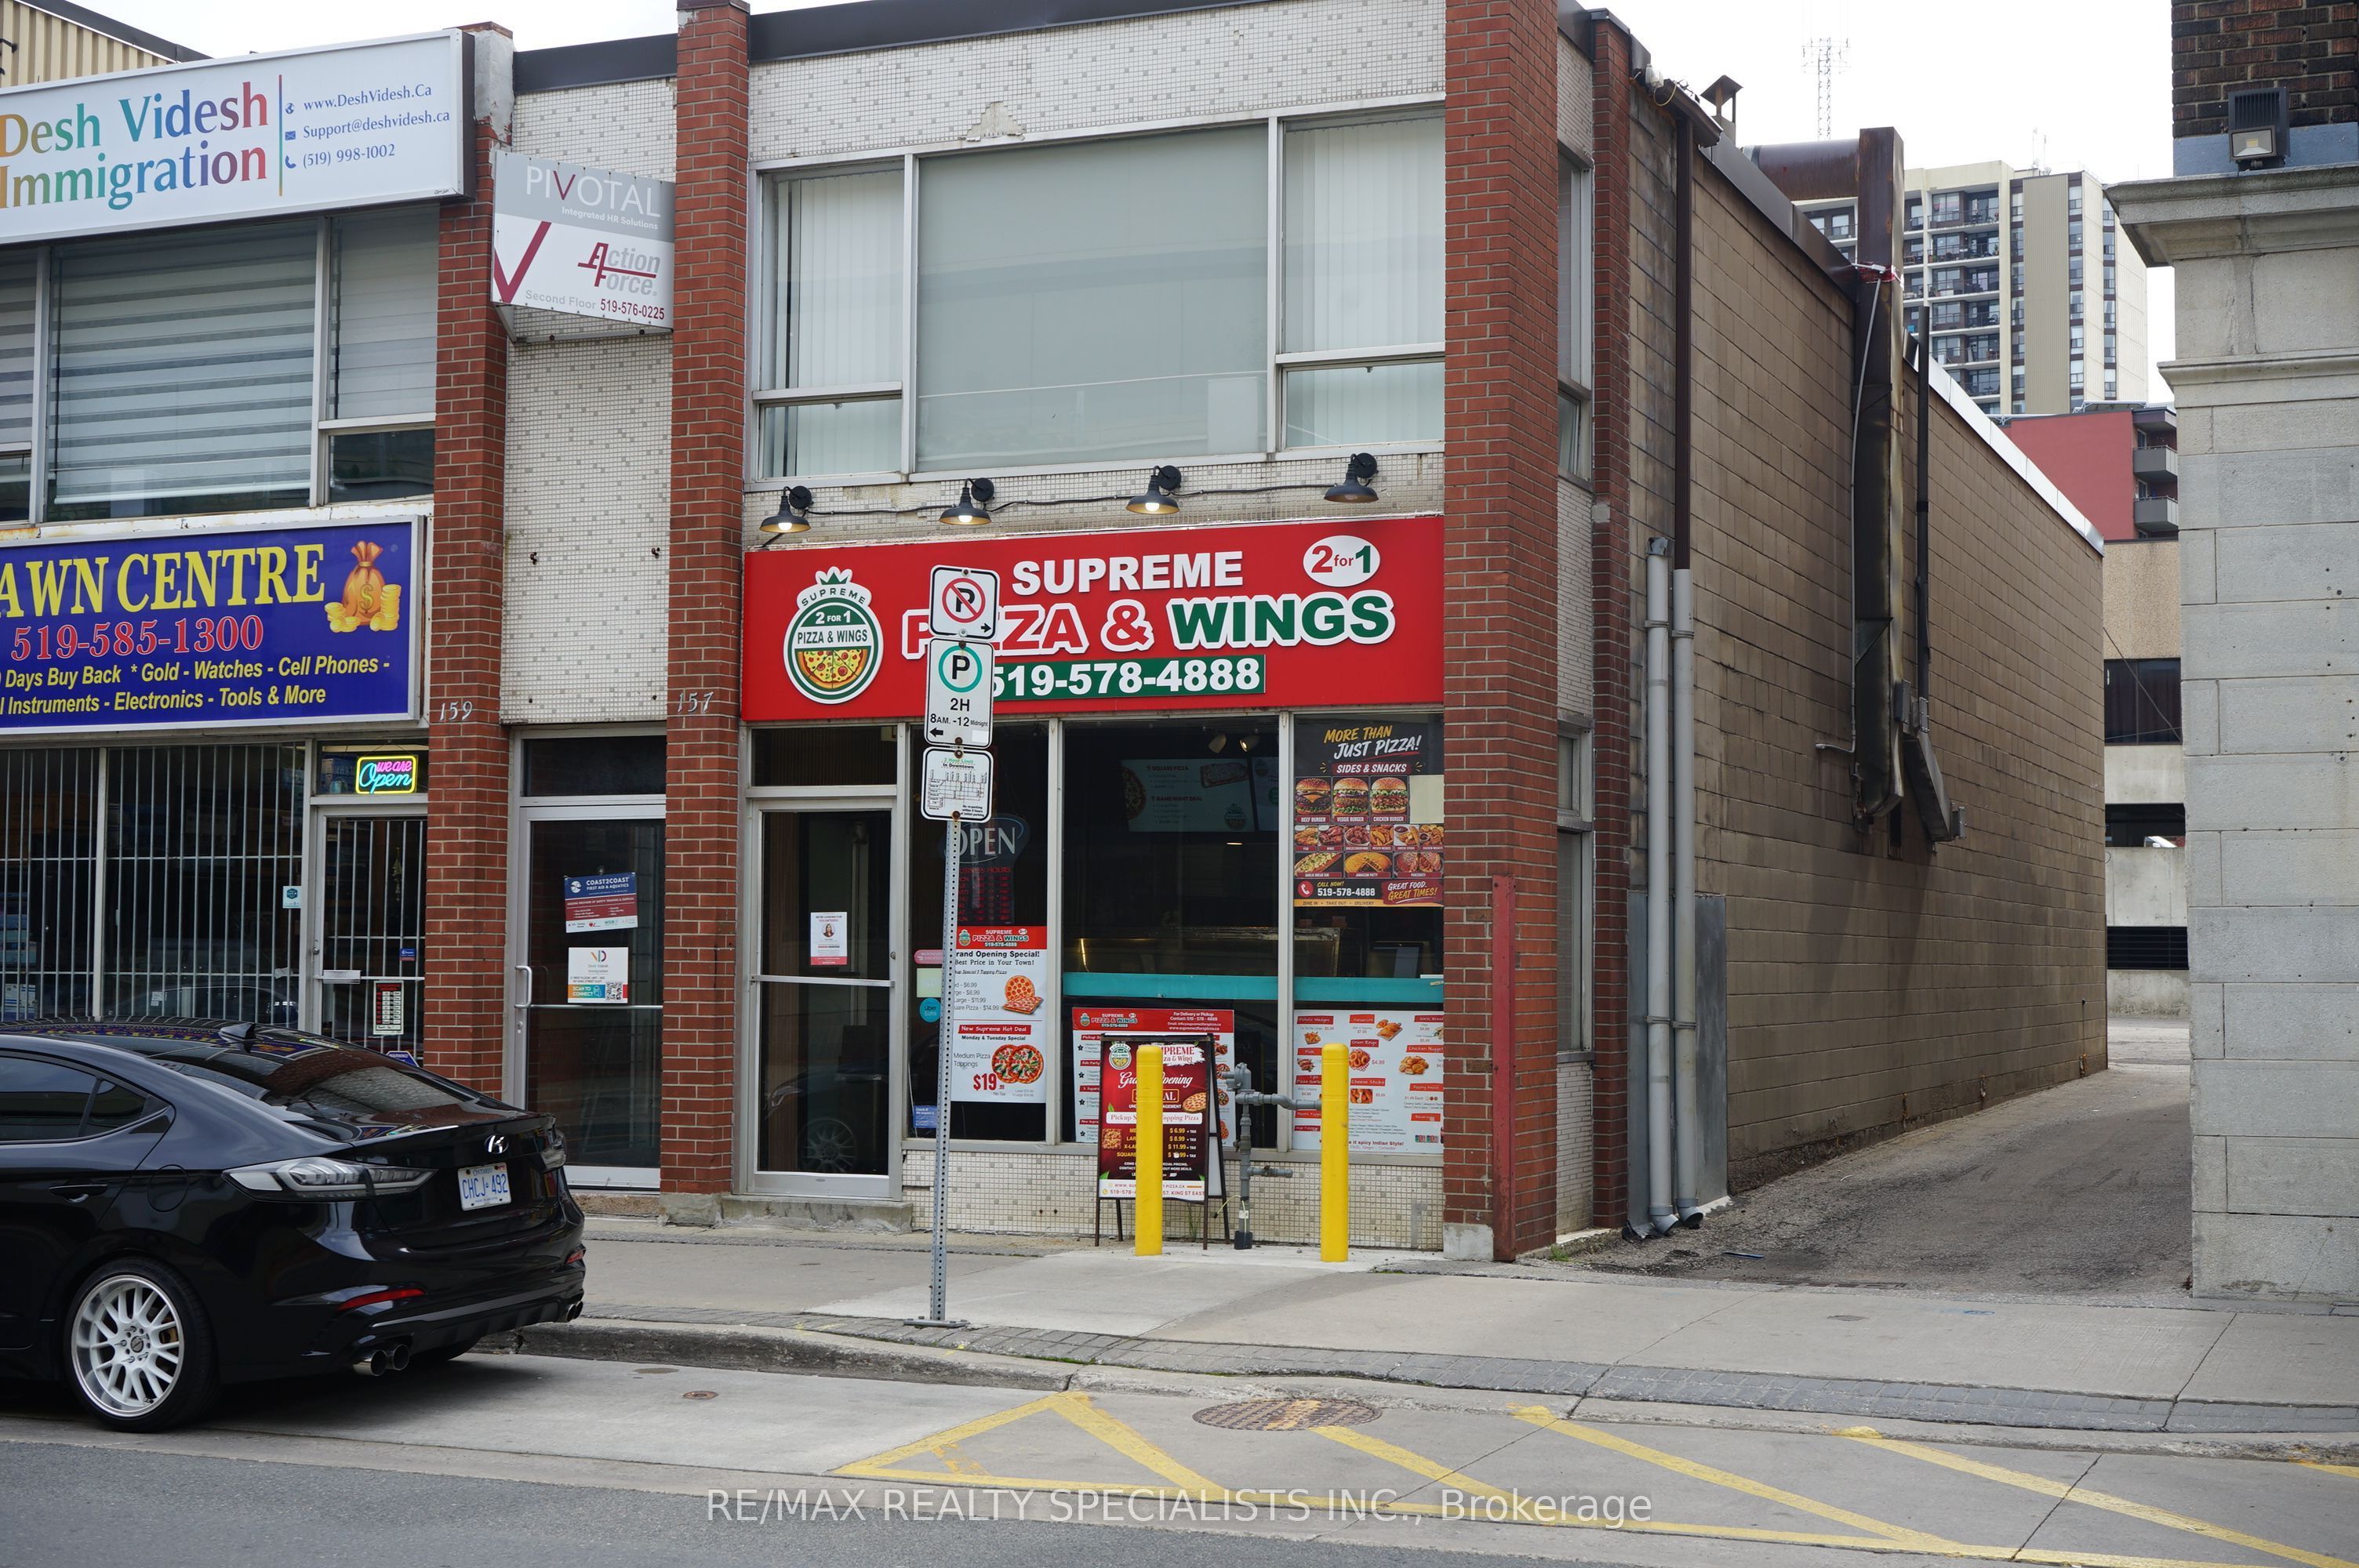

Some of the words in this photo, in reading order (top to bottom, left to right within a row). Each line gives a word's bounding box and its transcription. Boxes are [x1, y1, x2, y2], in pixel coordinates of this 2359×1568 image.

[304, 84, 431, 111] www.DeshVidesh.Ca
[0, 103, 100, 157] Desh
[118, 82, 267, 141] Videsh
[304, 110, 449, 139] Support@deshvidesh.ca
[303, 151, 331, 169] (519)
[337, 143, 394, 163] 998-1002
[0, 140, 267, 210] Immigration
[526, 165, 660, 217] PIVOTAL
[562, 207, 605, 222] Integrated
[607, 214, 619, 223] HR
[621, 216, 658, 230] Solutions
[525, 290, 565, 306] Second
[569, 297, 596, 310] Floor
[601, 299, 665, 320] 519-576-0225
[117, 544, 325, 612] CENTRE
[1012, 550, 1244, 596] SUPREME
[801, 588, 865, 606] SUPREME
[816, 612, 825, 624] 2
[844, 611, 850, 622] 1
[903, 603, 1089, 659] PZA
[1100, 599, 1154, 652] &
[1167, 590, 1394, 650] WINGS
[11, 614, 264, 661] 519-585-1300
[798, 631, 823, 644] PIZZA
[827, 631, 833, 642] &
[837, 630, 867, 642] WINGS
[5, 670, 43, 691] Days
[47, 668, 77, 690] Buy
[82, 666, 121, 684] Back
[142, 662, 179, 682] Gold
[194, 660, 263, 680] Watches
[278, 657, 310, 676] Cell
[315, 655, 379, 674] Phones
[952, 655, 970, 679] P
[994, 658, 1259, 697] 519-578-4888
[9, 695, 100, 714] Instruments
[114, 690, 203, 711] Electronics
[220, 688, 261, 706] Tools
[267, 686, 278, 704] &
[285, 685, 325, 704] More
[440, 701, 473, 722] 159
[678, 692, 714, 713] 157
[951, 698, 969, 711] 2H
[1325, 728, 1359, 743] MORE
[1363, 725, 1392, 739] THAN
[1334, 741, 1372, 759] JUST
[1375, 735, 1422, 757] PIZZA!
[360, 763, 412, 793] Open
[376, 761, 392, 772] we
[393, 760, 412, 771] are
[1336, 764, 1361, 773] SIDES
[1363, 764, 1369, 773] &
[1371, 764, 1407, 772] SNACKS
[1388, 891, 1411, 901] GREAT
[1413, 887, 1437, 898] TIMES!
[973, 1073, 997, 1091] $19
[1118, 1072, 1137, 1088] Gra
